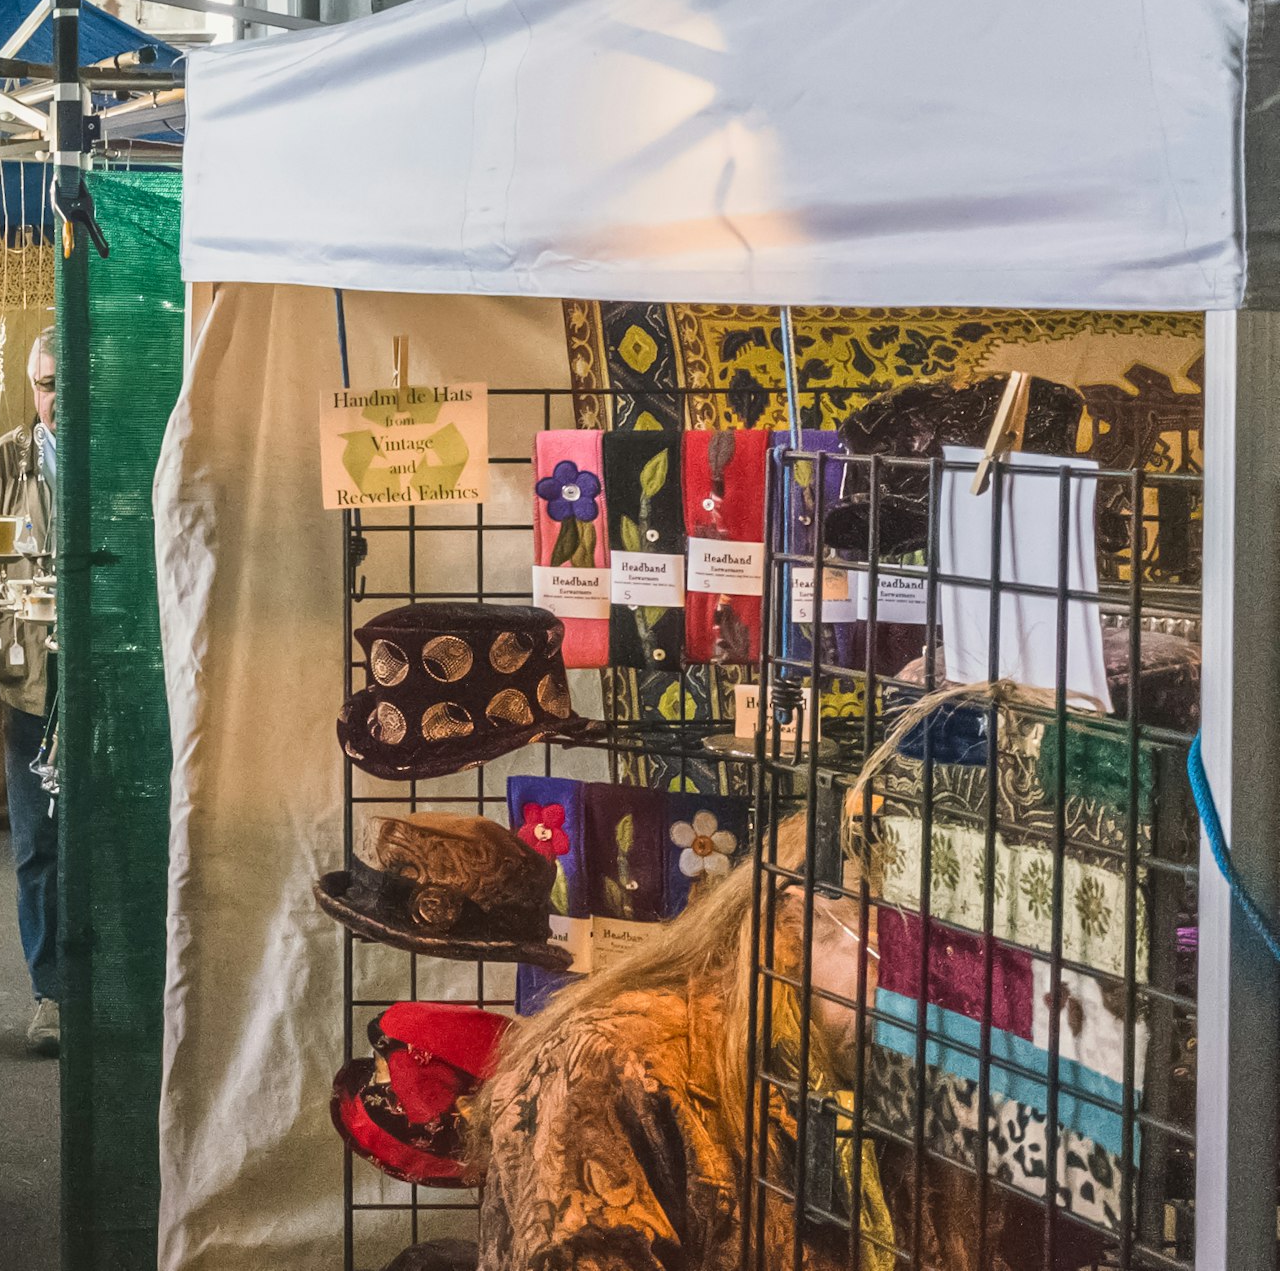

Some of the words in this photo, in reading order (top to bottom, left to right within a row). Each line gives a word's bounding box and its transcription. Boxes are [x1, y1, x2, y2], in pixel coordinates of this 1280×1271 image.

[334, 390, 426, 408] Handmde
[434, 386, 473, 403] Hats
[385, 415, 415, 427] from
[371, 435, 434, 453] Vintage
[389, 460, 417, 474] and
[336, 486, 412, 506] Recycled
[418, 482, 479, 502] Fabrics
[703, 553, 752, 565] Headband
[621, 562, 666, 573] Headband
[552, 577, 599, 587] Headband
[877, 579, 924, 590] eadband
